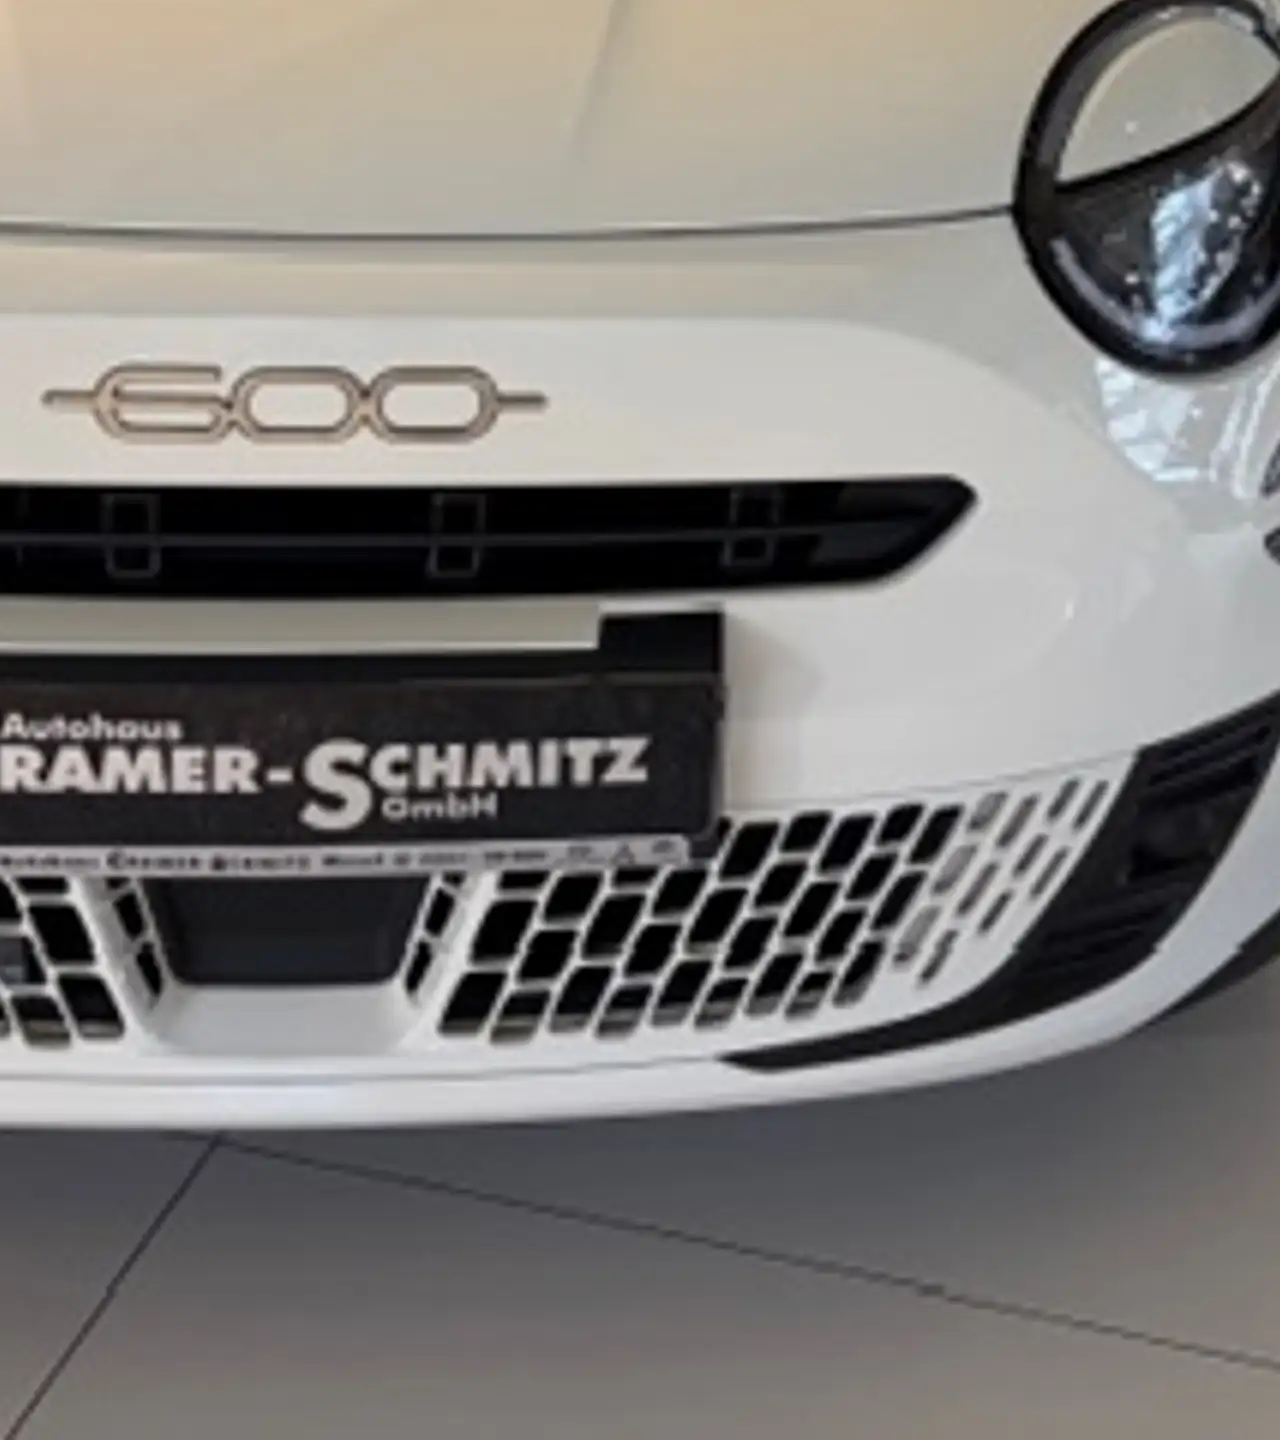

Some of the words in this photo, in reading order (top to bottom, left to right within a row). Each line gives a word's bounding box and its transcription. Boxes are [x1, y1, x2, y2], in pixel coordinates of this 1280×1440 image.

[90, 364, 501, 444] 600
[0, 711, 184, 741] Autohaus
[381, 792, 498, 821] GmbH
